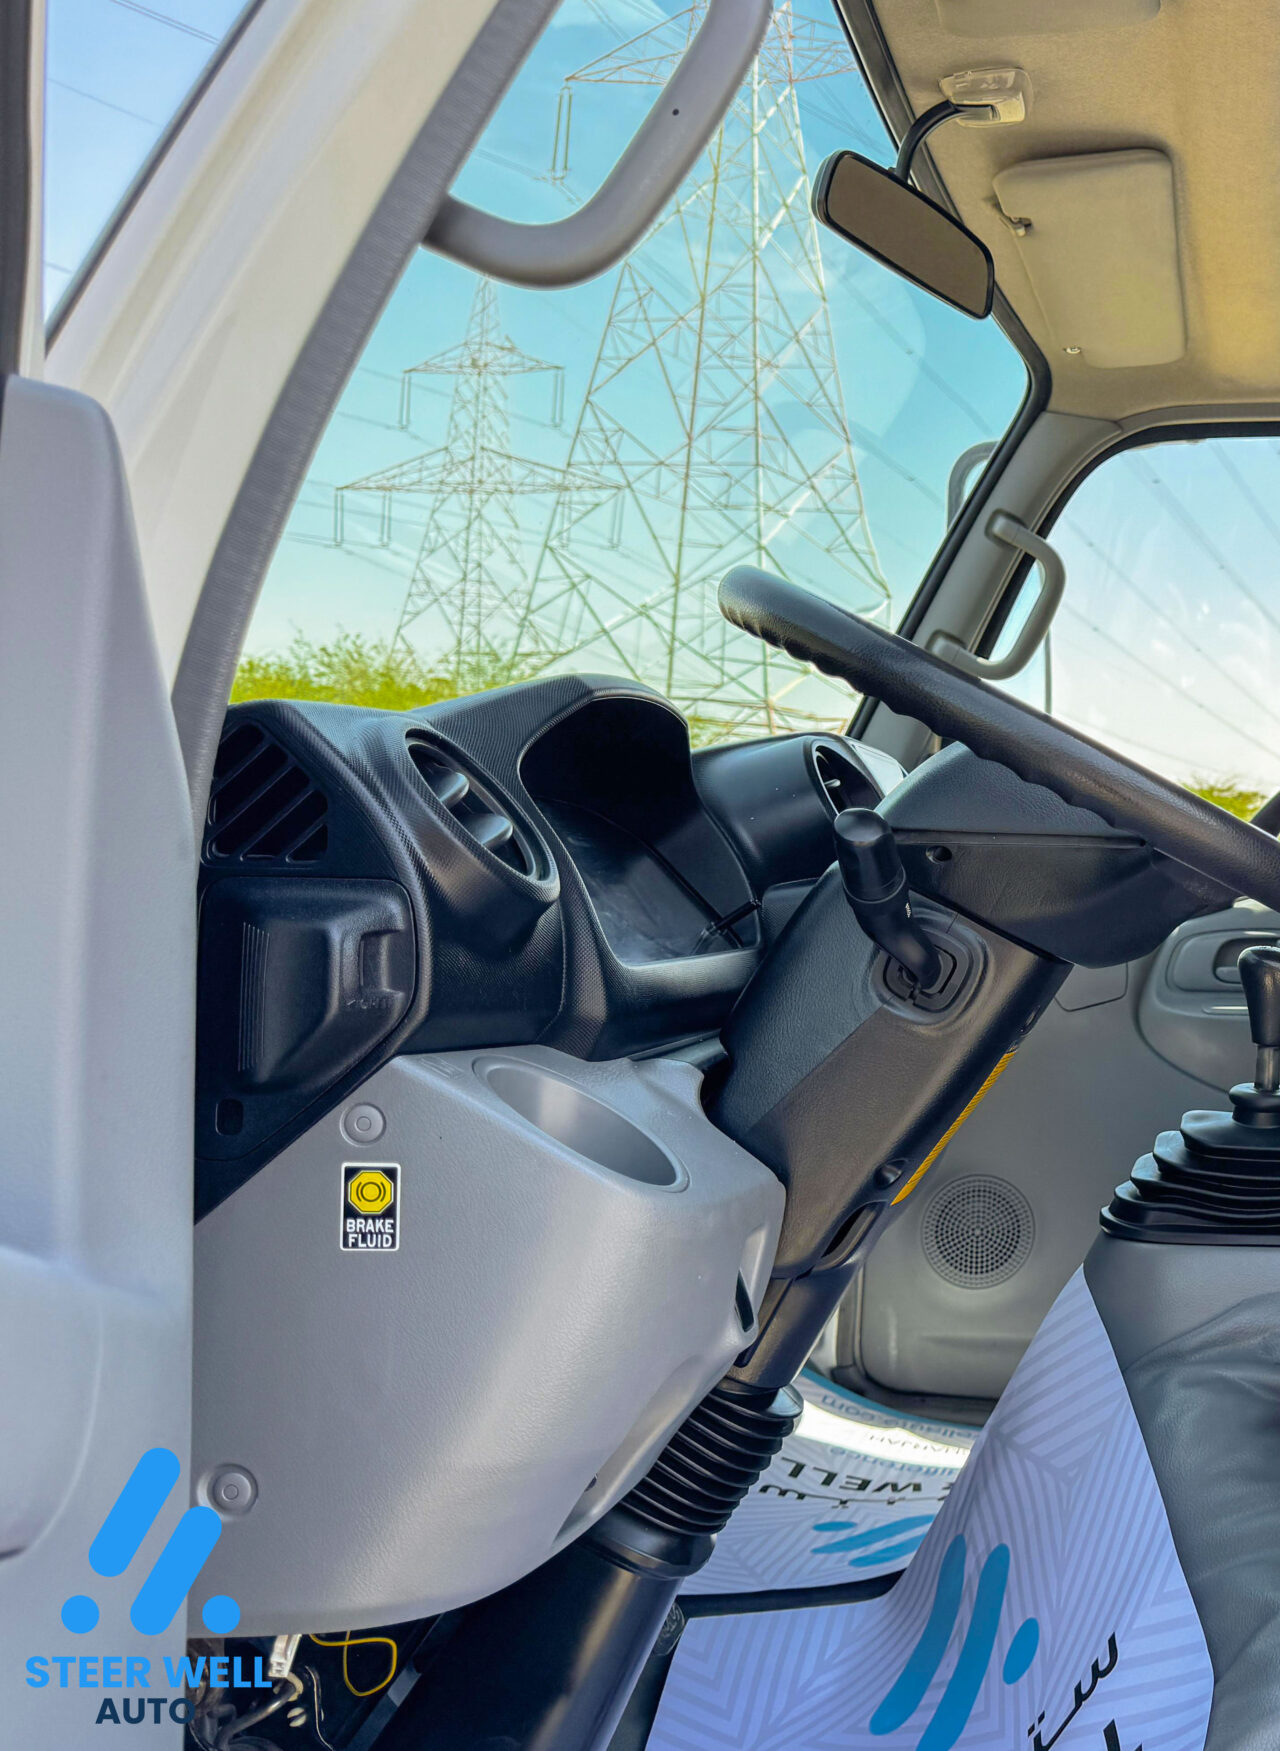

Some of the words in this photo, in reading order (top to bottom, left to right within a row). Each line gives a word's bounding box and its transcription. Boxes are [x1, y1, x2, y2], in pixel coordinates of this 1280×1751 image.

[346, 1218, 394, 1233] BRAKE
[348, 1233, 393, 1248] FLUID
[821, 1394, 979, 1439] ellauto.com
[780, 1457, 923, 1494] WELL
